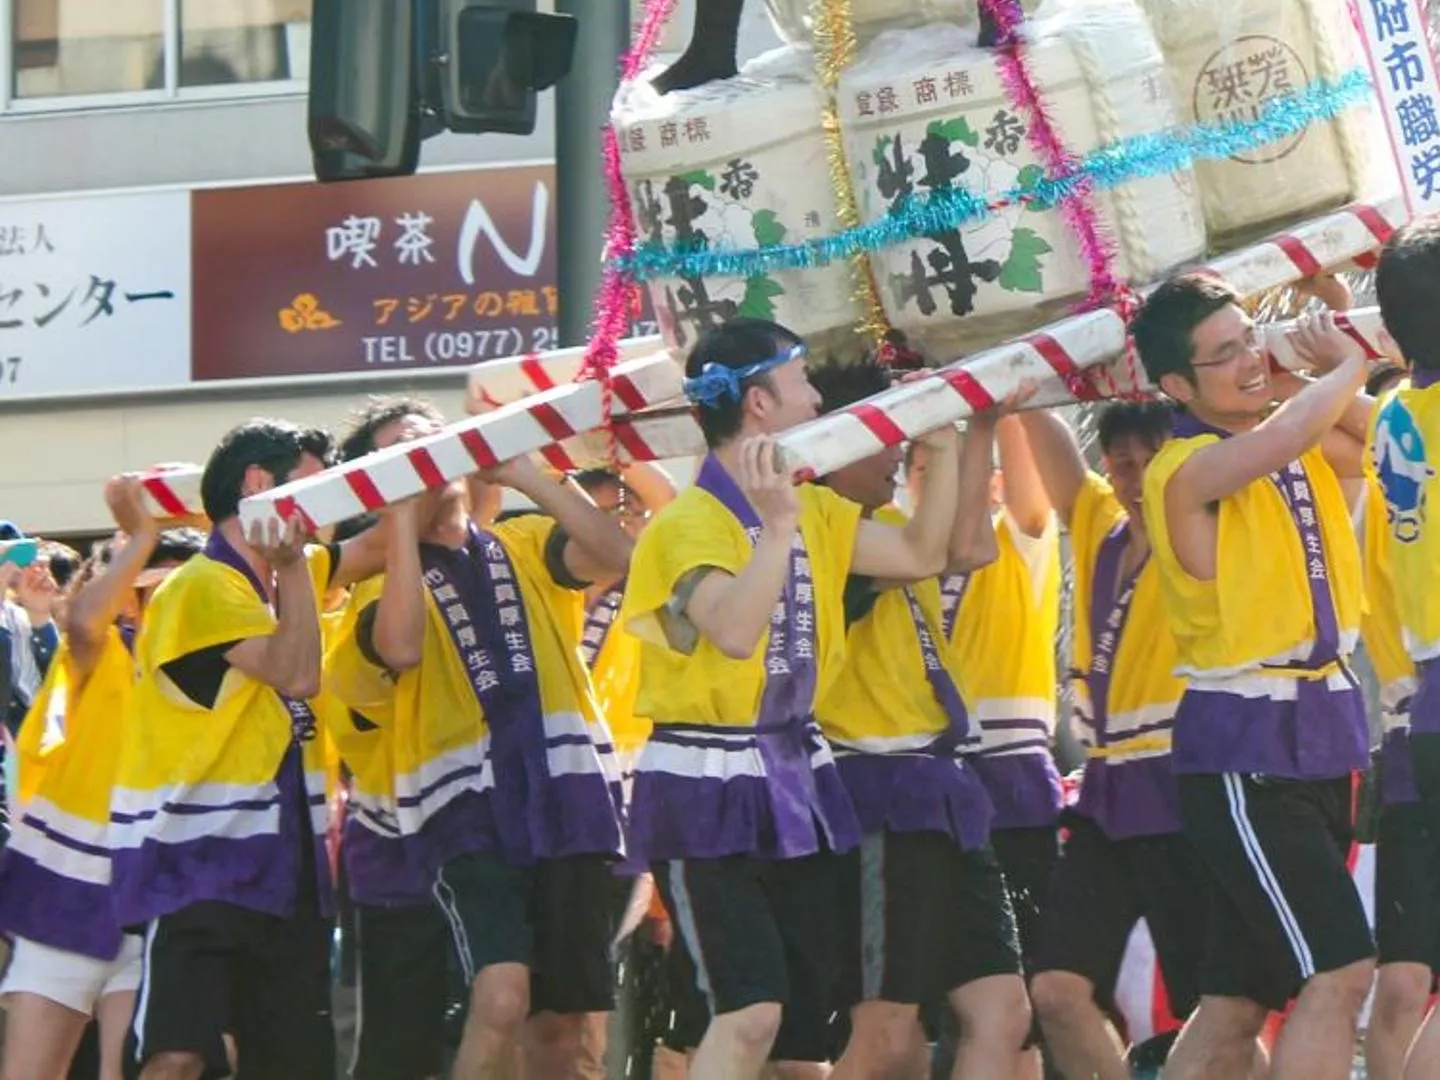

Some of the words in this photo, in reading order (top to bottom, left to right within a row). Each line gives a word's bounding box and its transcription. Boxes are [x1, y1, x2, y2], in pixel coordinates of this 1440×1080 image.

[325, 210, 437, 270] 喫茶
[361, 335, 415, 364] TEL
[424, 326, 524, 362] (0977)
